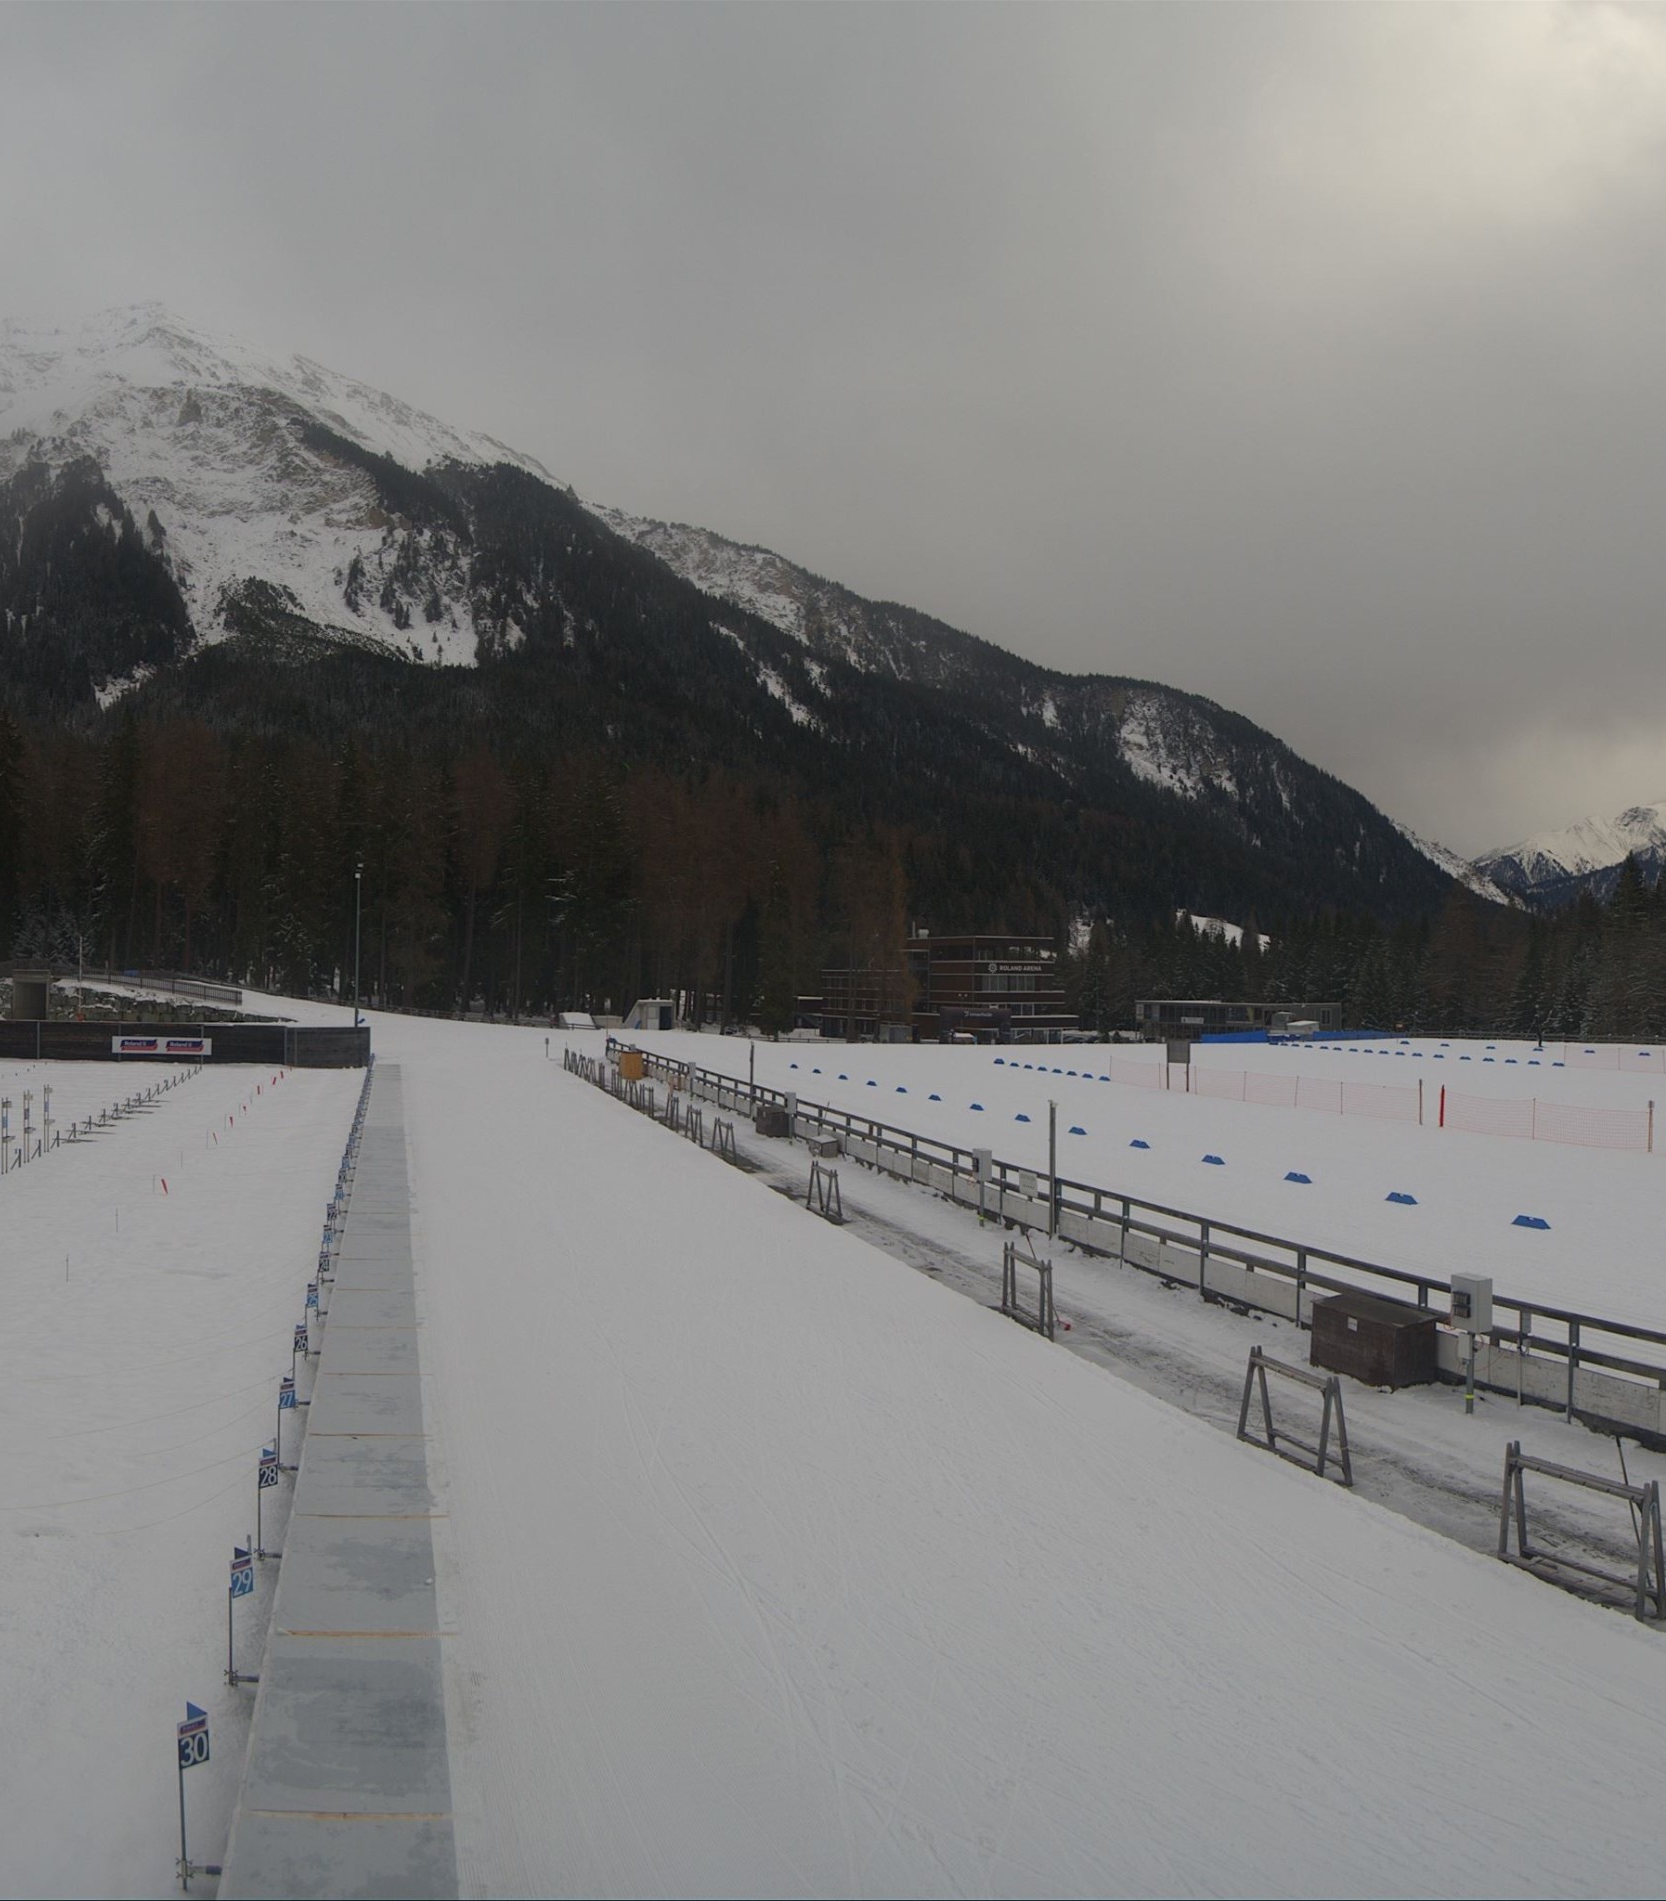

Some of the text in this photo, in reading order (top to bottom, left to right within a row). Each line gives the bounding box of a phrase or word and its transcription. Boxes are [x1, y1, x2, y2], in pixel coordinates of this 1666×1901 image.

[295, 1336, 307, 1351] 26
[280, 1393, 293, 1407] 27
[259, 1466, 278, 1488] 28
[233, 1568, 253, 1597] 29
[180, 1731, 208, 1768] 30
